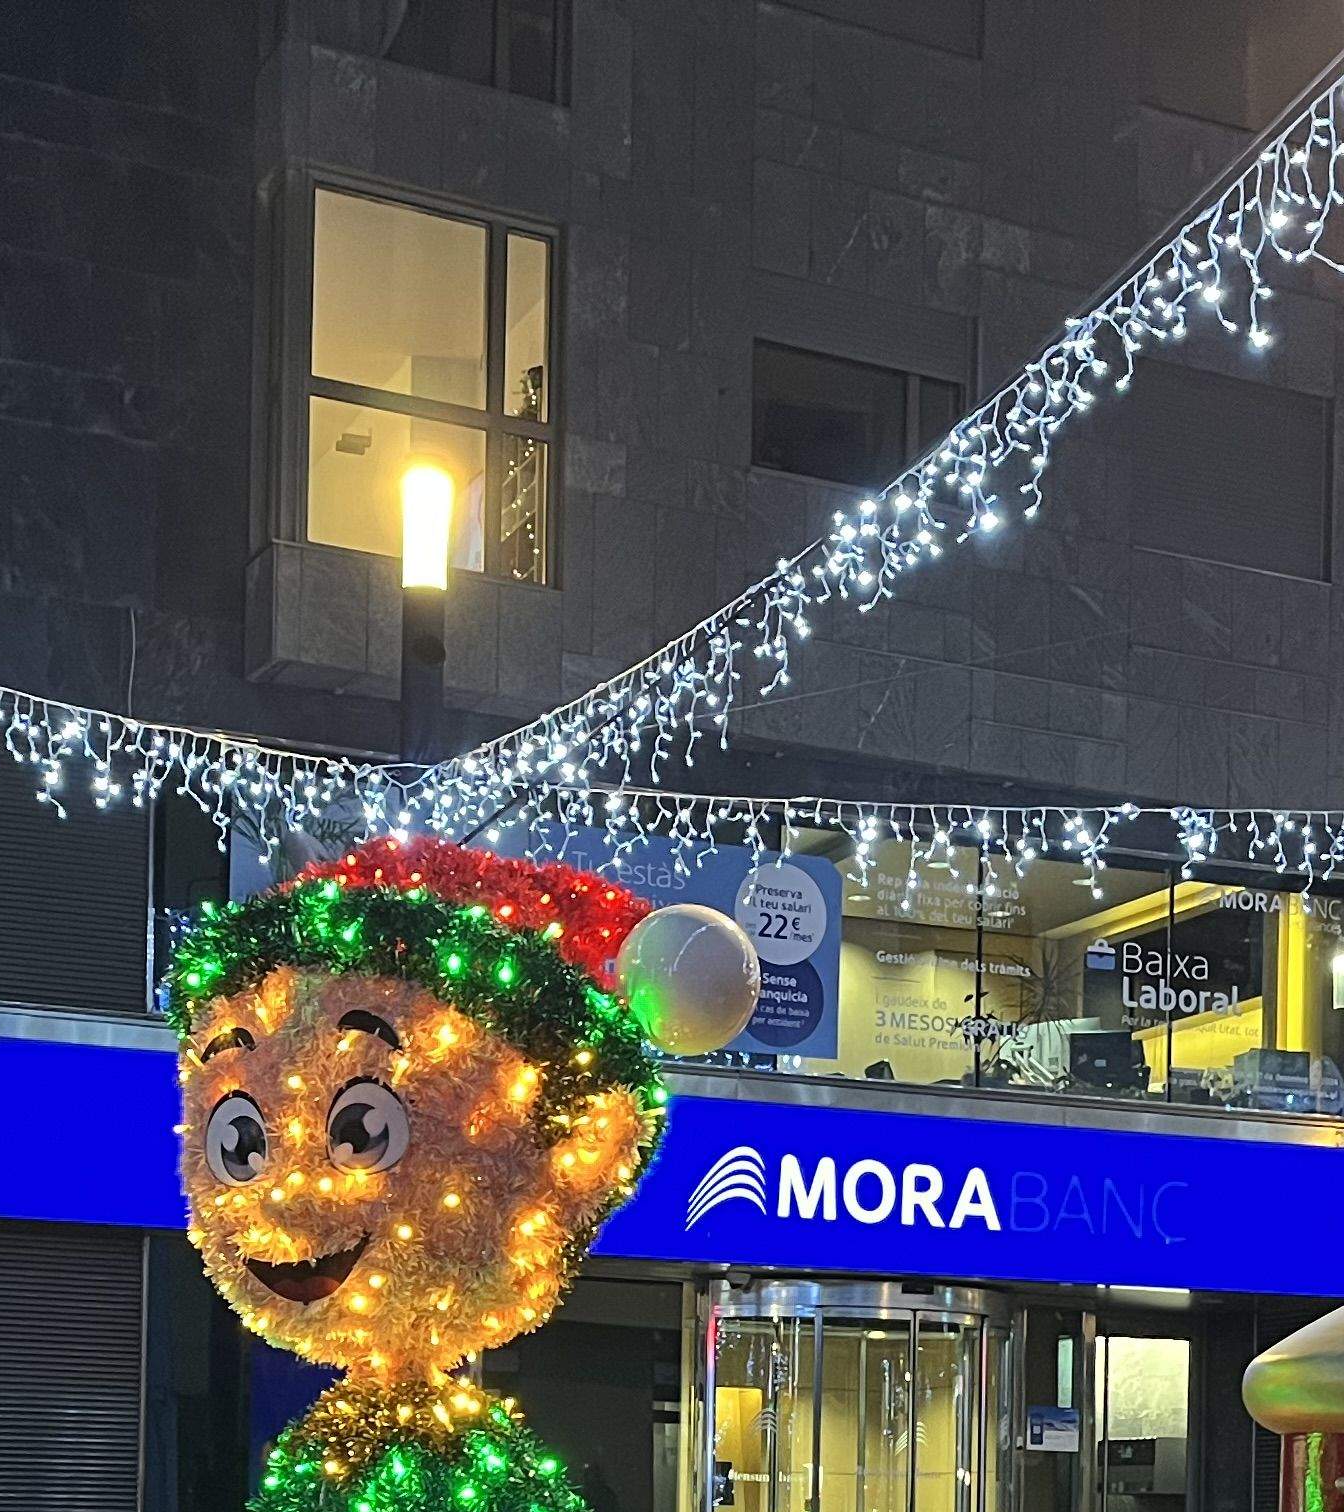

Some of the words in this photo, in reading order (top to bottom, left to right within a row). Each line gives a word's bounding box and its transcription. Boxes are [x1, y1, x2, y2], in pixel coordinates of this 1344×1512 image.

[617, 860, 686, 891] estàs
[755, 884, 803, 900] Preserva
[781, 900, 812, 914] salari
[960, 957, 987, 973] dels
[1122, 941, 1209, 981] Baixa
[762, 972, 797, 987] Sense
[1122, 975, 1243, 1016] Laboral
[875, 1010, 886, 1027] 3
[890, 1012, 956, 1034] MESOS
[961, 1018, 1030, 1040] GRATIS
[875, 1034, 890, 1045] de
[893, 1034, 925, 1049] Salut
[776, 1153, 1189, 1246] MORABANC
